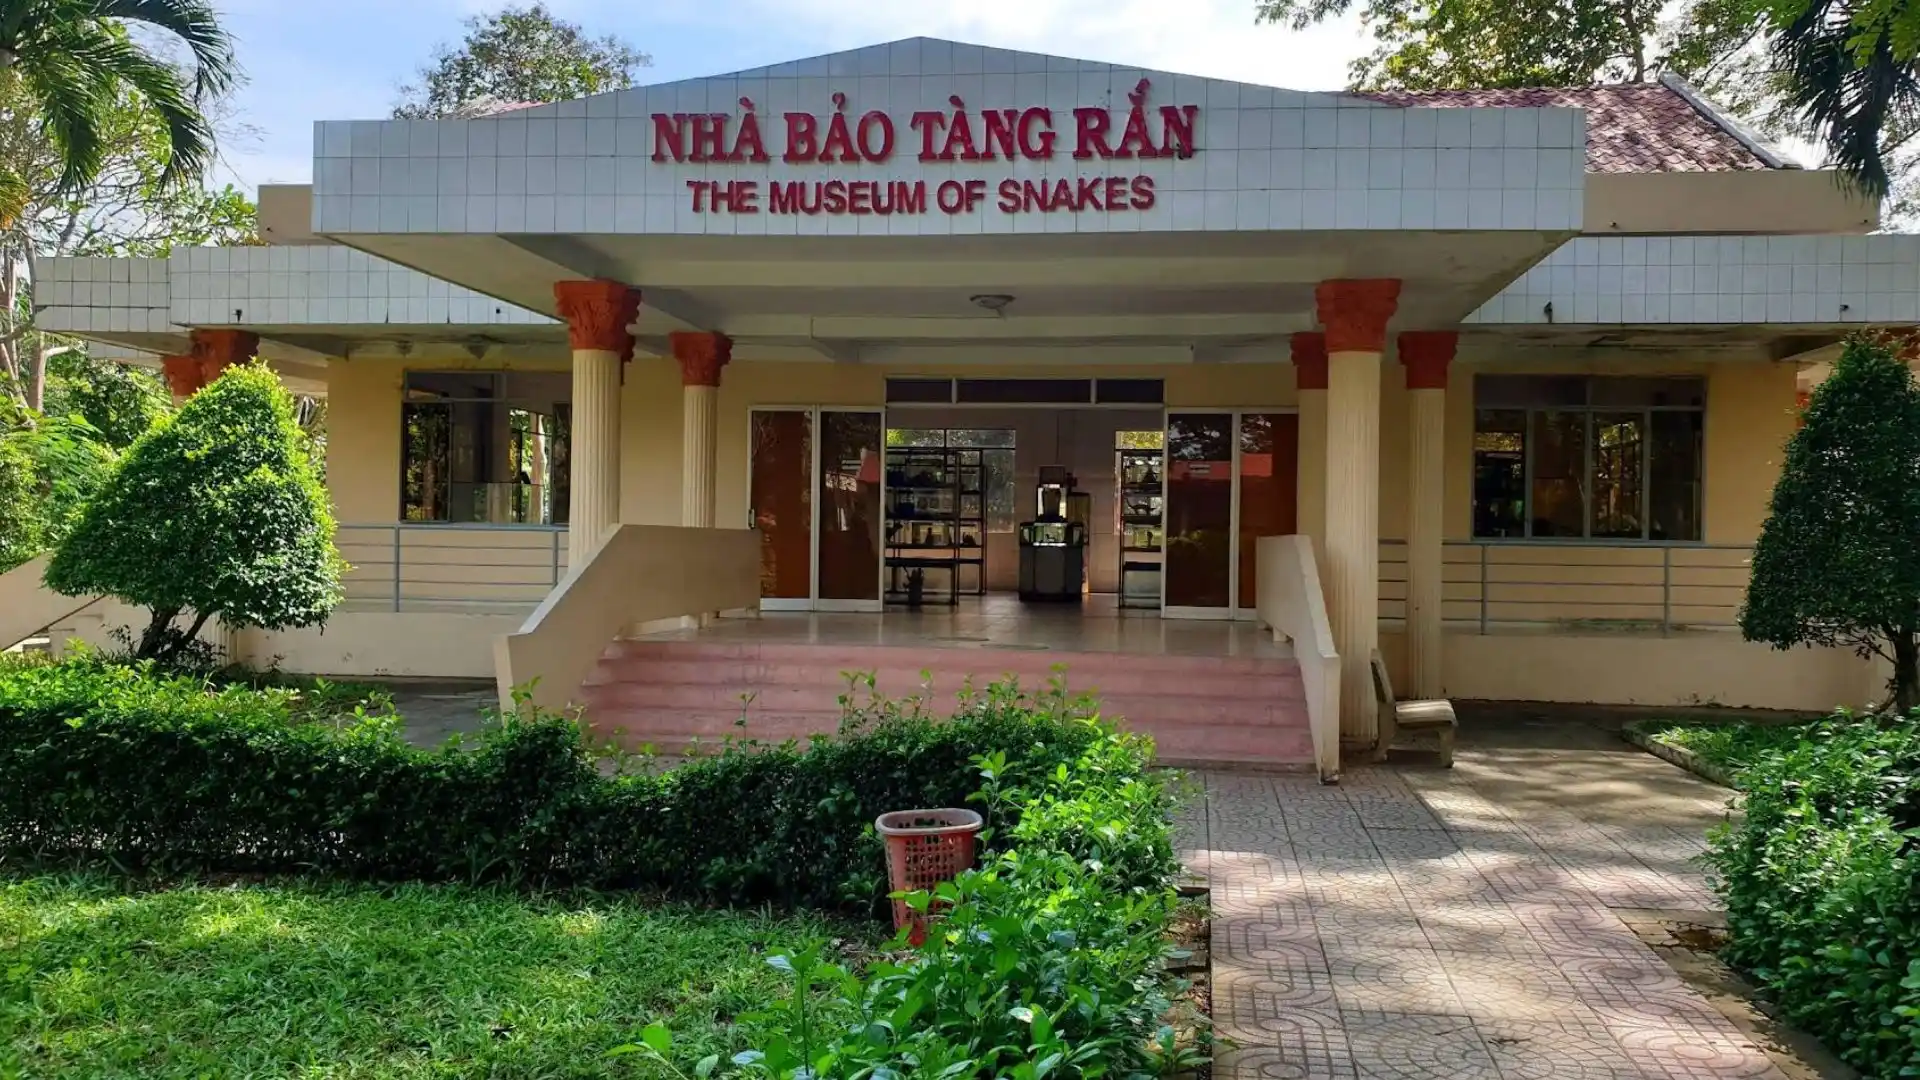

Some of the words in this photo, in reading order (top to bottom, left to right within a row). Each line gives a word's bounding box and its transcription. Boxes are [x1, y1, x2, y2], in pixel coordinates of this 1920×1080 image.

[650, 97, 770, 162] NHÀ
[782, 92, 895, 162] BẢO
[910, 94, 1056, 161] TÀNG
[1072, 78, 1198, 159] RẮN
[687, 180, 758, 213] THE
[769, 180, 926, 215] MUSEUM
[937, 179, 985, 213] OF
[998, 175, 1154, 212] SNAKES
